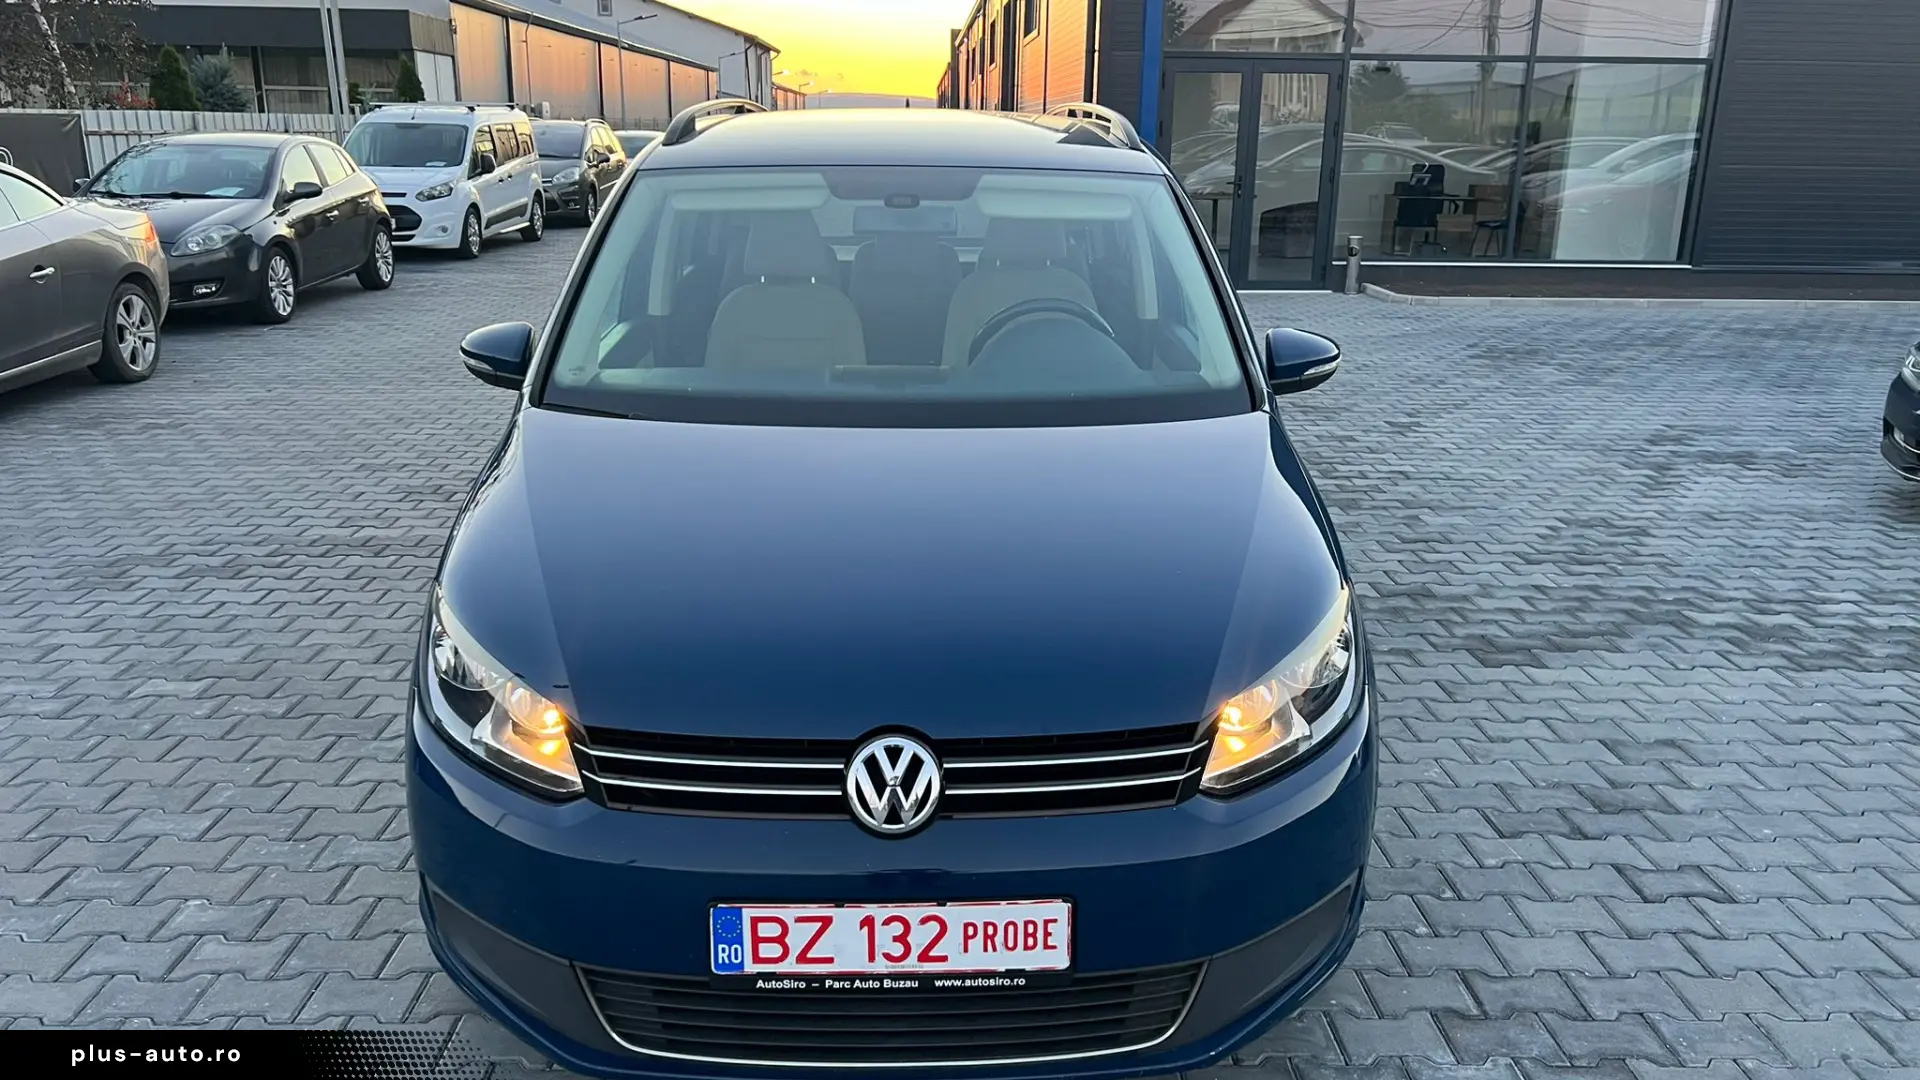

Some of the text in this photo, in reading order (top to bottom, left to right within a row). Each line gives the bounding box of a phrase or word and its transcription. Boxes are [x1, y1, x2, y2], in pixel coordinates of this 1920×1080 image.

[750, 914, 1058, 964] BZ 132 PROBE
[717, 944, 742, 964] RO
[756, 979, 806, 989] AutoSiro
[825, 979, 851, 989] Parc
[853, 979, 881, 989] Auto
[883, 978, 919, 988] Buzau
[934, 976, 1026, 987] www.autosiro.ro
